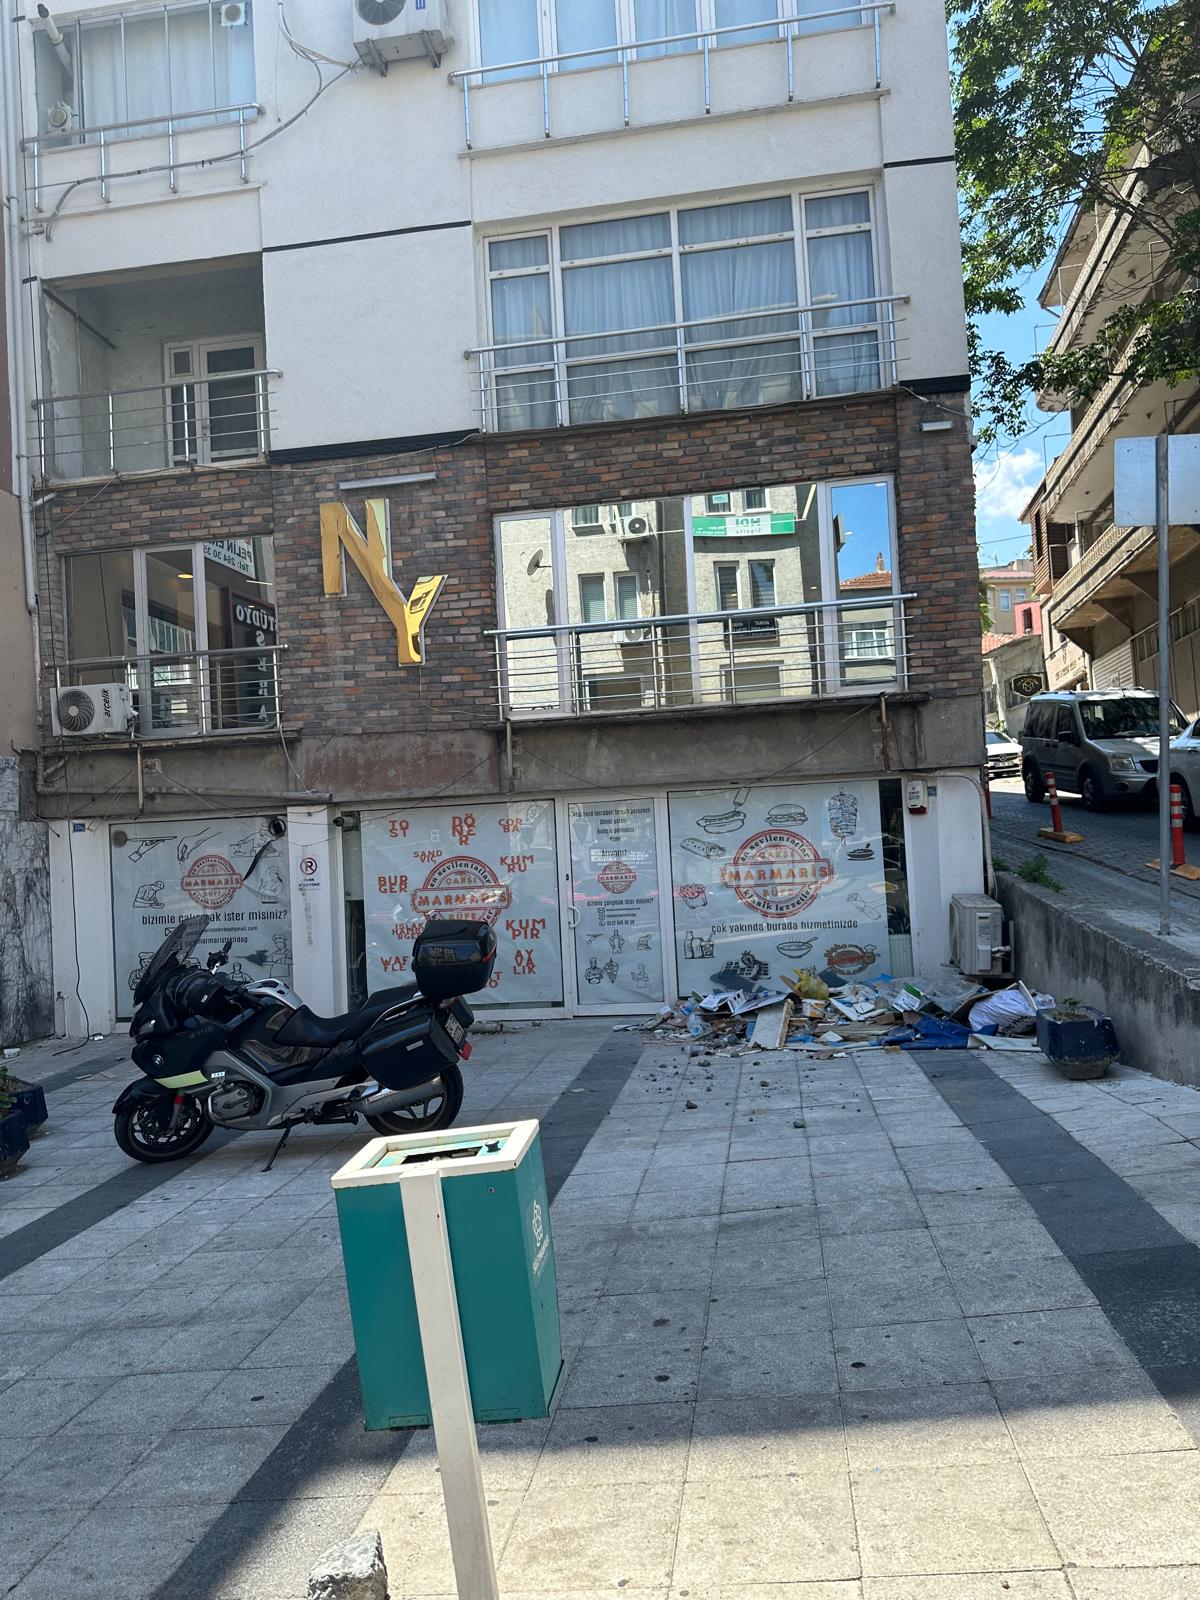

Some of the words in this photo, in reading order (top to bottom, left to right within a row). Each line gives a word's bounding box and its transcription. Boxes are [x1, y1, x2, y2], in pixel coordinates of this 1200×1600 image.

[104, 688, 112, 718] arçelik
[506, 918, 546, 930] KUM
[711, 923, 727, 936] çok
[729, 922, 764, 934] yakında
[766, 920, 798, 931] burada
[800, 918, 858, 930] hizmetinizde
